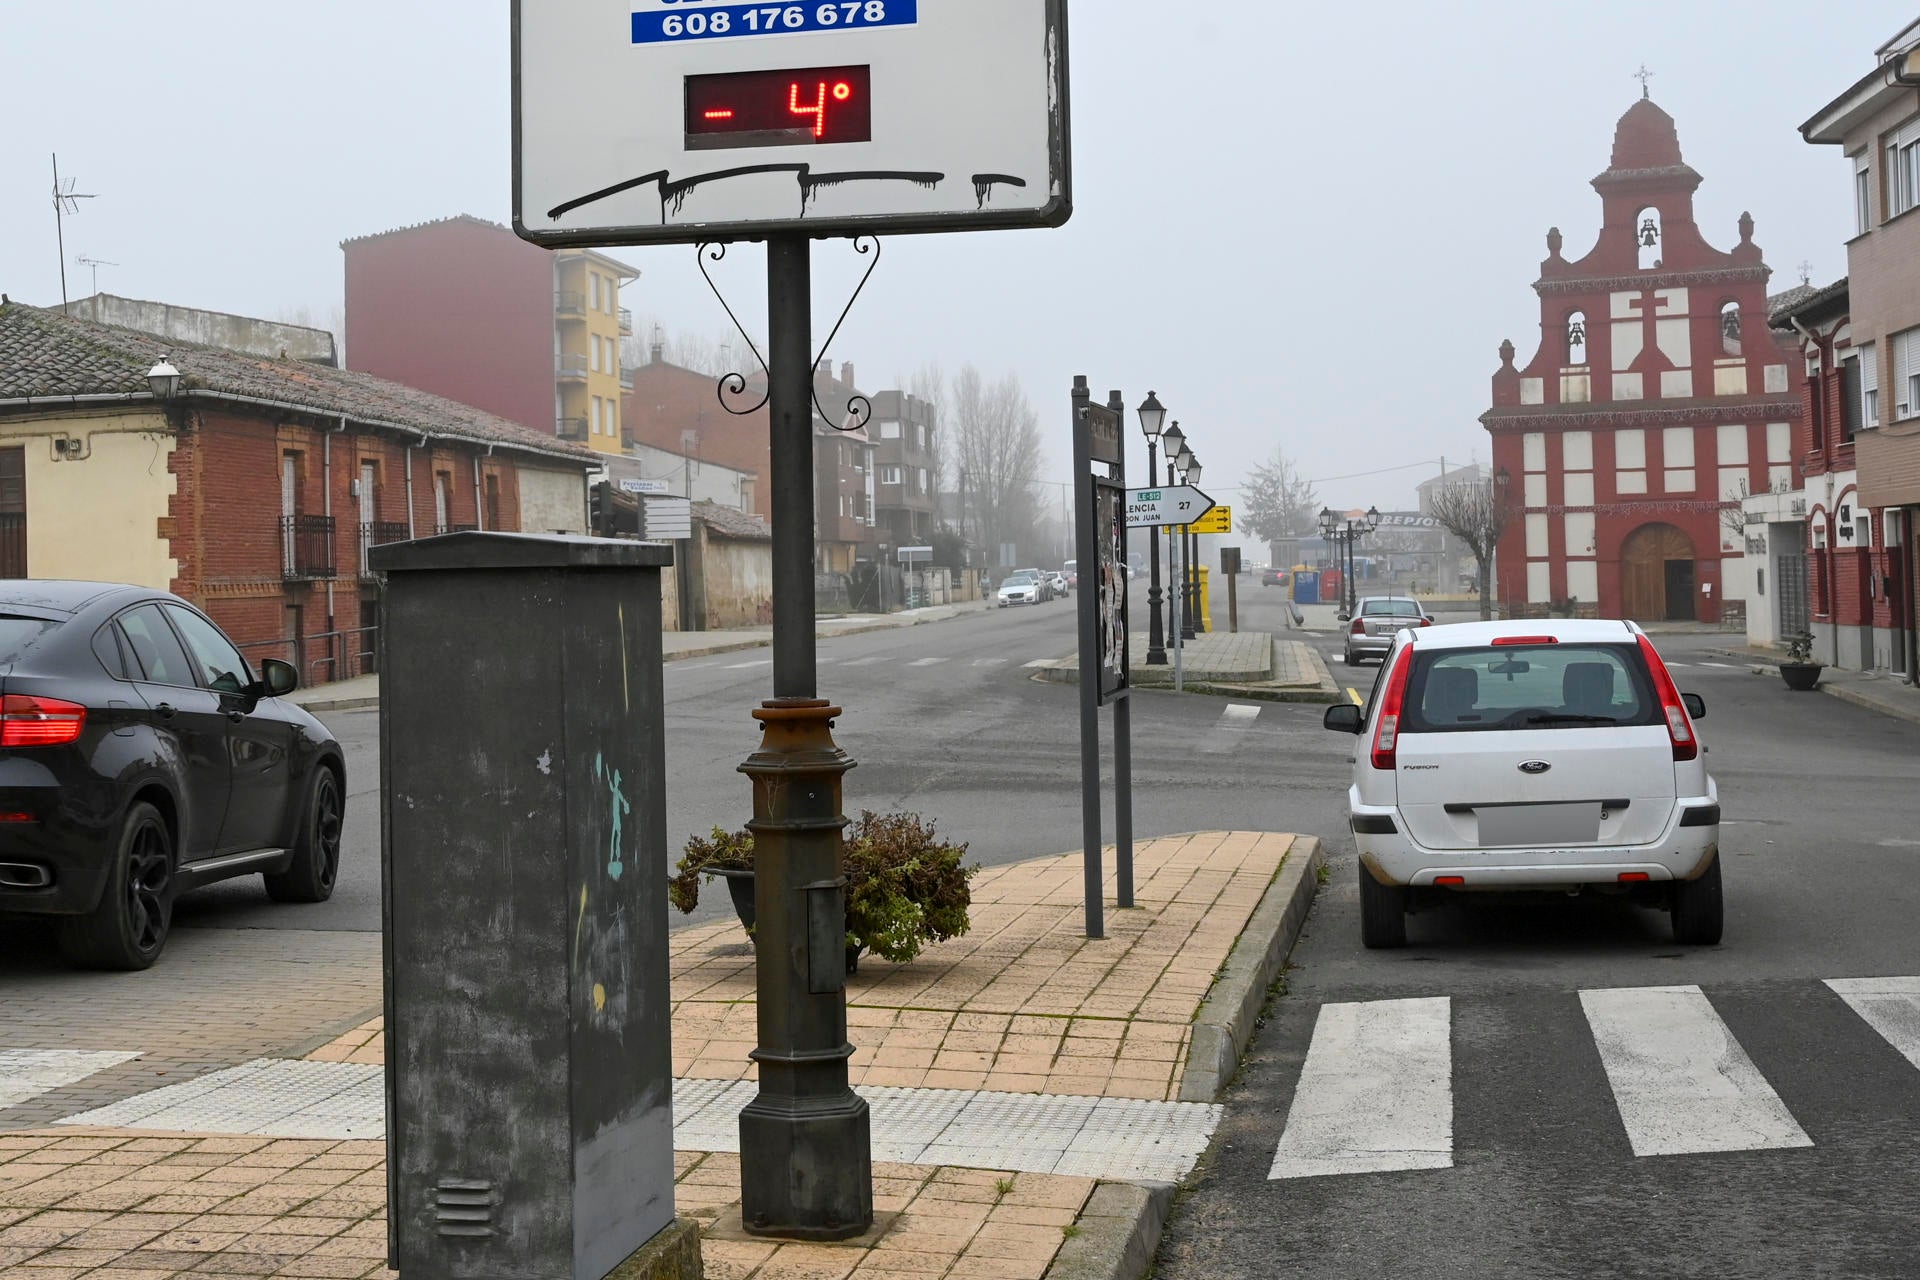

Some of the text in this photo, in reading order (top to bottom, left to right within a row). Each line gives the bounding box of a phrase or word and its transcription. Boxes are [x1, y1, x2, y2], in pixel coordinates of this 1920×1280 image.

[662, 0, 886, 36] 608 176 678
[1178, 501, 1190, 510] 27
